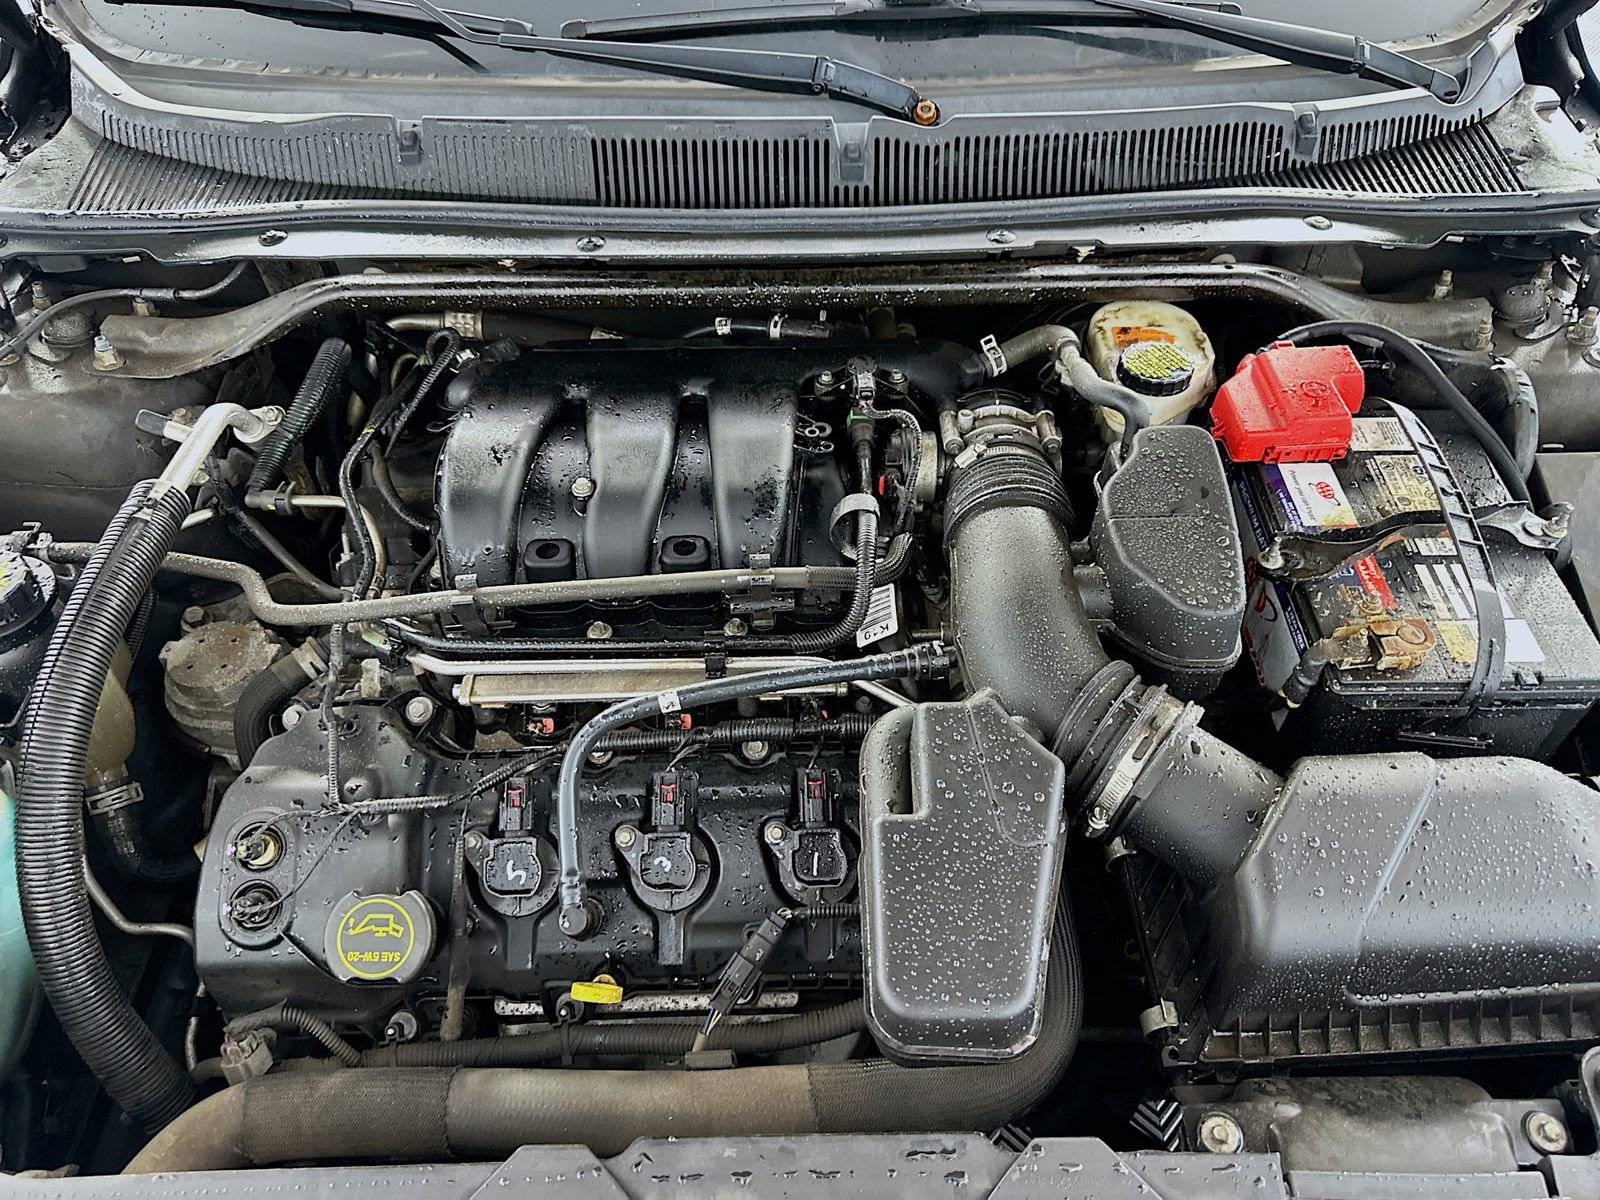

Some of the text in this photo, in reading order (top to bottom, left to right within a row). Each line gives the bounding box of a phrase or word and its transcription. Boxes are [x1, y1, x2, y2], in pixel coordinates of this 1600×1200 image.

[1294, 487, 1304, 496] you
[1239, 481, 1259, 528] PREMIUM
[507, 861, 526, 884] 5
[381, 952, 401, 962] SAE
